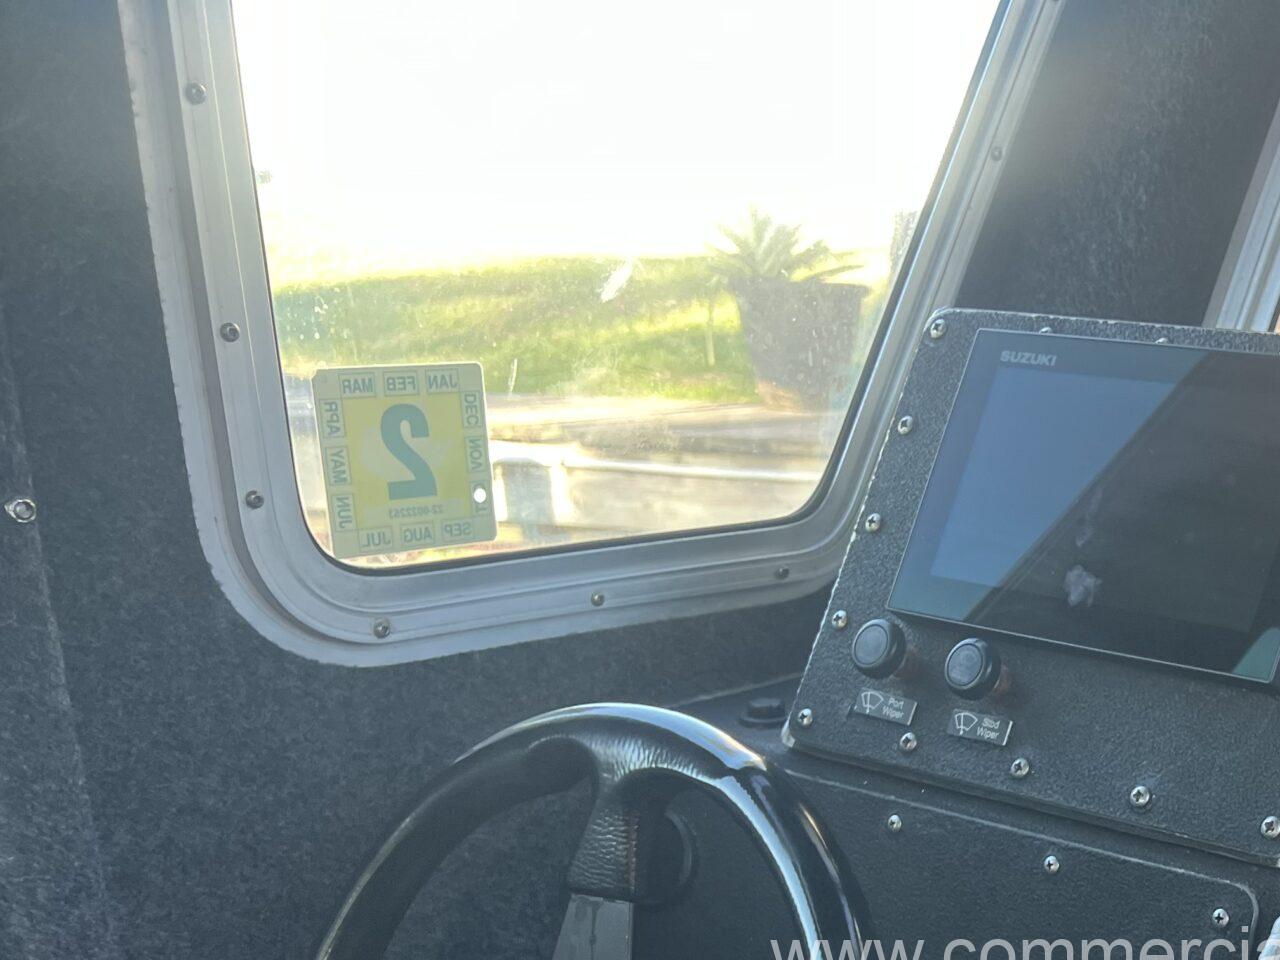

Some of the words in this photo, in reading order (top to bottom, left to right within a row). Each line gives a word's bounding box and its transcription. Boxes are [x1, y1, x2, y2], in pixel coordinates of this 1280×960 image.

[1000, 350, 1057, 366] SUZUKI
[889, 697, 904, 710] Port
[882, 705, 904, 719] Wiper
[976, 726, 1000, 740] Wiper
